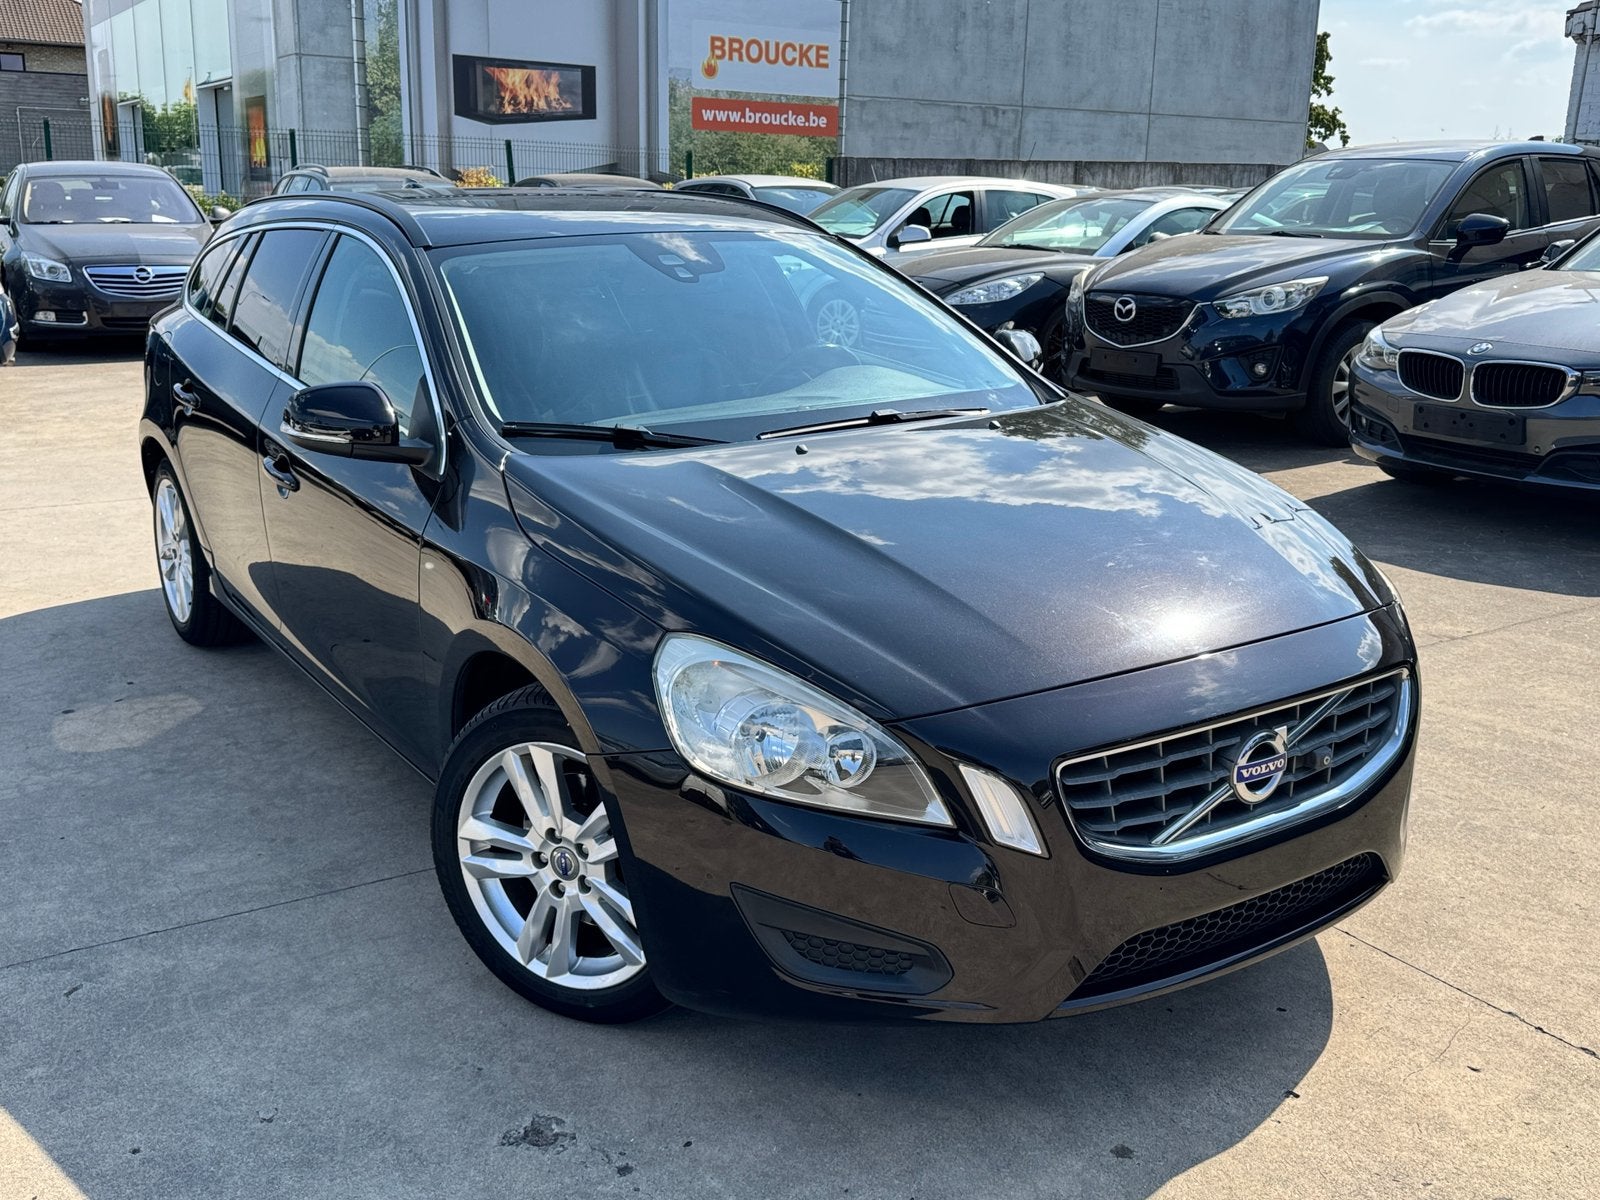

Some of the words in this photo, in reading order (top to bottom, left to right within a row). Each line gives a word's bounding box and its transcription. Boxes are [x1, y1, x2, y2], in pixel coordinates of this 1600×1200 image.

[710, 35, 829, 69] BROUCKE
[702, 107, 827, 127] www.broucke.be
[1240, 758, 1284, 778] VOLVO
